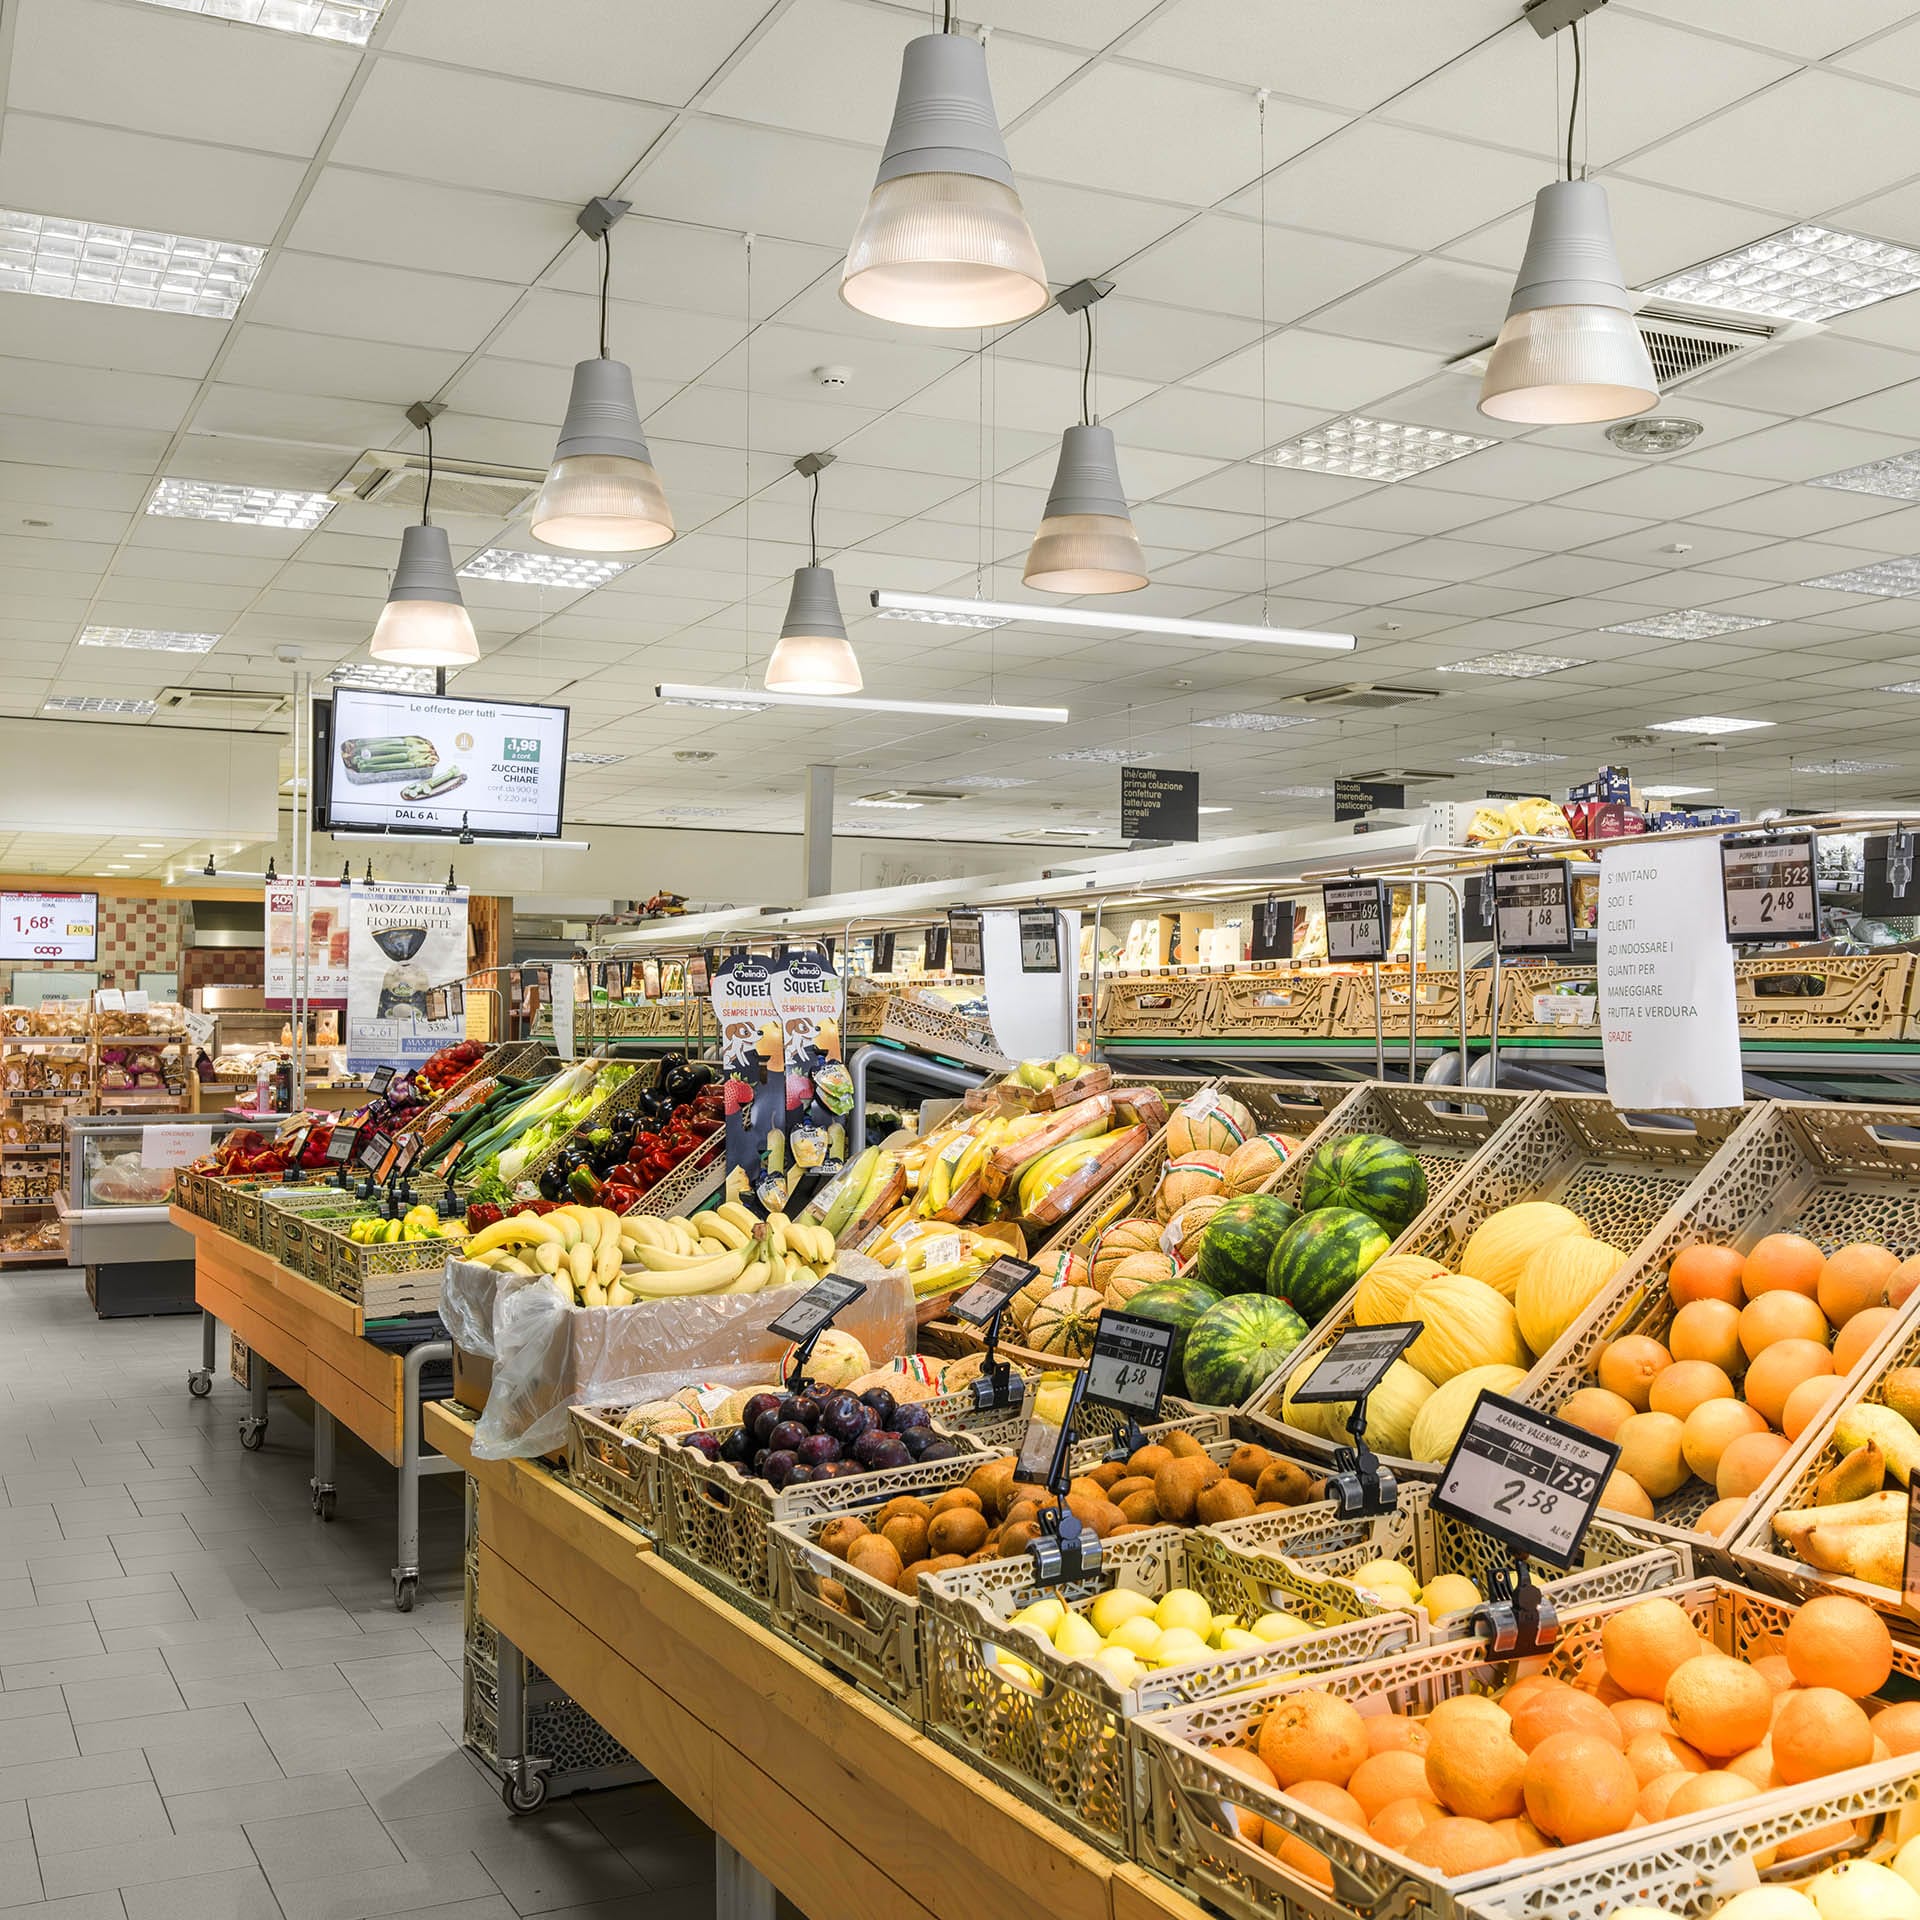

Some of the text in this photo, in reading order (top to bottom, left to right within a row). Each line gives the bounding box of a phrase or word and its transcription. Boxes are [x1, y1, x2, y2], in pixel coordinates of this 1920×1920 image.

[410, 704, 496, 718] Le offerte per tutti
[491, 764, 540, 775] ZUCCHINE
[1123, 769, 1157, 780] thè/caffè
[503, 774, 539, 784] CHIARE
[1123, 780, 1184, 791] prima colazione
[1336, 782, 1361, 792] biscotti
[1123, 789, 1162, 799] confetture
[1336, 792, 1374, 802] merendine
[1123, 798, 1161, 808] latte/uova
[1336, 801, 1373, 810] pasticceria
[395, 810, 416, 819] DAL
[418, 811, 424, 820] 6
[1123, 808, 1150, 817] cereali
[1784, 866, 1809, 886] 523
[1543, 887, 1562, 904] 381
[1608, 894, 1633, 908] SOCI E
[367, 903, 452, 916] MOZZARELLA
[1362, 903, 1378, 919] 692
[1760, 891, 1794, 922] 2,48
[1527, 908, 1552, 937] 1,68
[1608, 919, 1636, 932] CLIENTI
[1350, 922, 1369, 948] 1,68
[34, 946, 63, 956] coop
[1608, 944, 1618, 956] AD
[1619, 941, 1668, 955] INDOSSARE
[1608, 963, 1656, 976] GUANTI PER
[1608, 984, 1663, 997] MANEGGIARE
[722, 1008, 749, 1017] SEMPRE
[781, 1004, 806, 1014] SEMPRE
[815, 1005, 836, 1014] TASCA
[1608, 1005, 1698, 1018] FRUTTA E VERDURA
[1608, 1031, 1632, 1043] GRAZIE
[1143, 1347, 1165, 1367] 113
[1115, 1364, 1147, 1394] 4,58
[1495, 1413, 1526, 1433] ARANCE
[1527, 1426, 1563, 1449] VALENCIA
[1569, 1446, 1578, 1456] IT
[1578, 1449, 1591, 1459] SF
[1509, 1439, 1534, 1457] ITALIA
[1551, 1465, 1596, 1498] 759
[1449, 1479, 1558, 1515] € 2,58
[1550, 1524, 1561, 1534] AL
